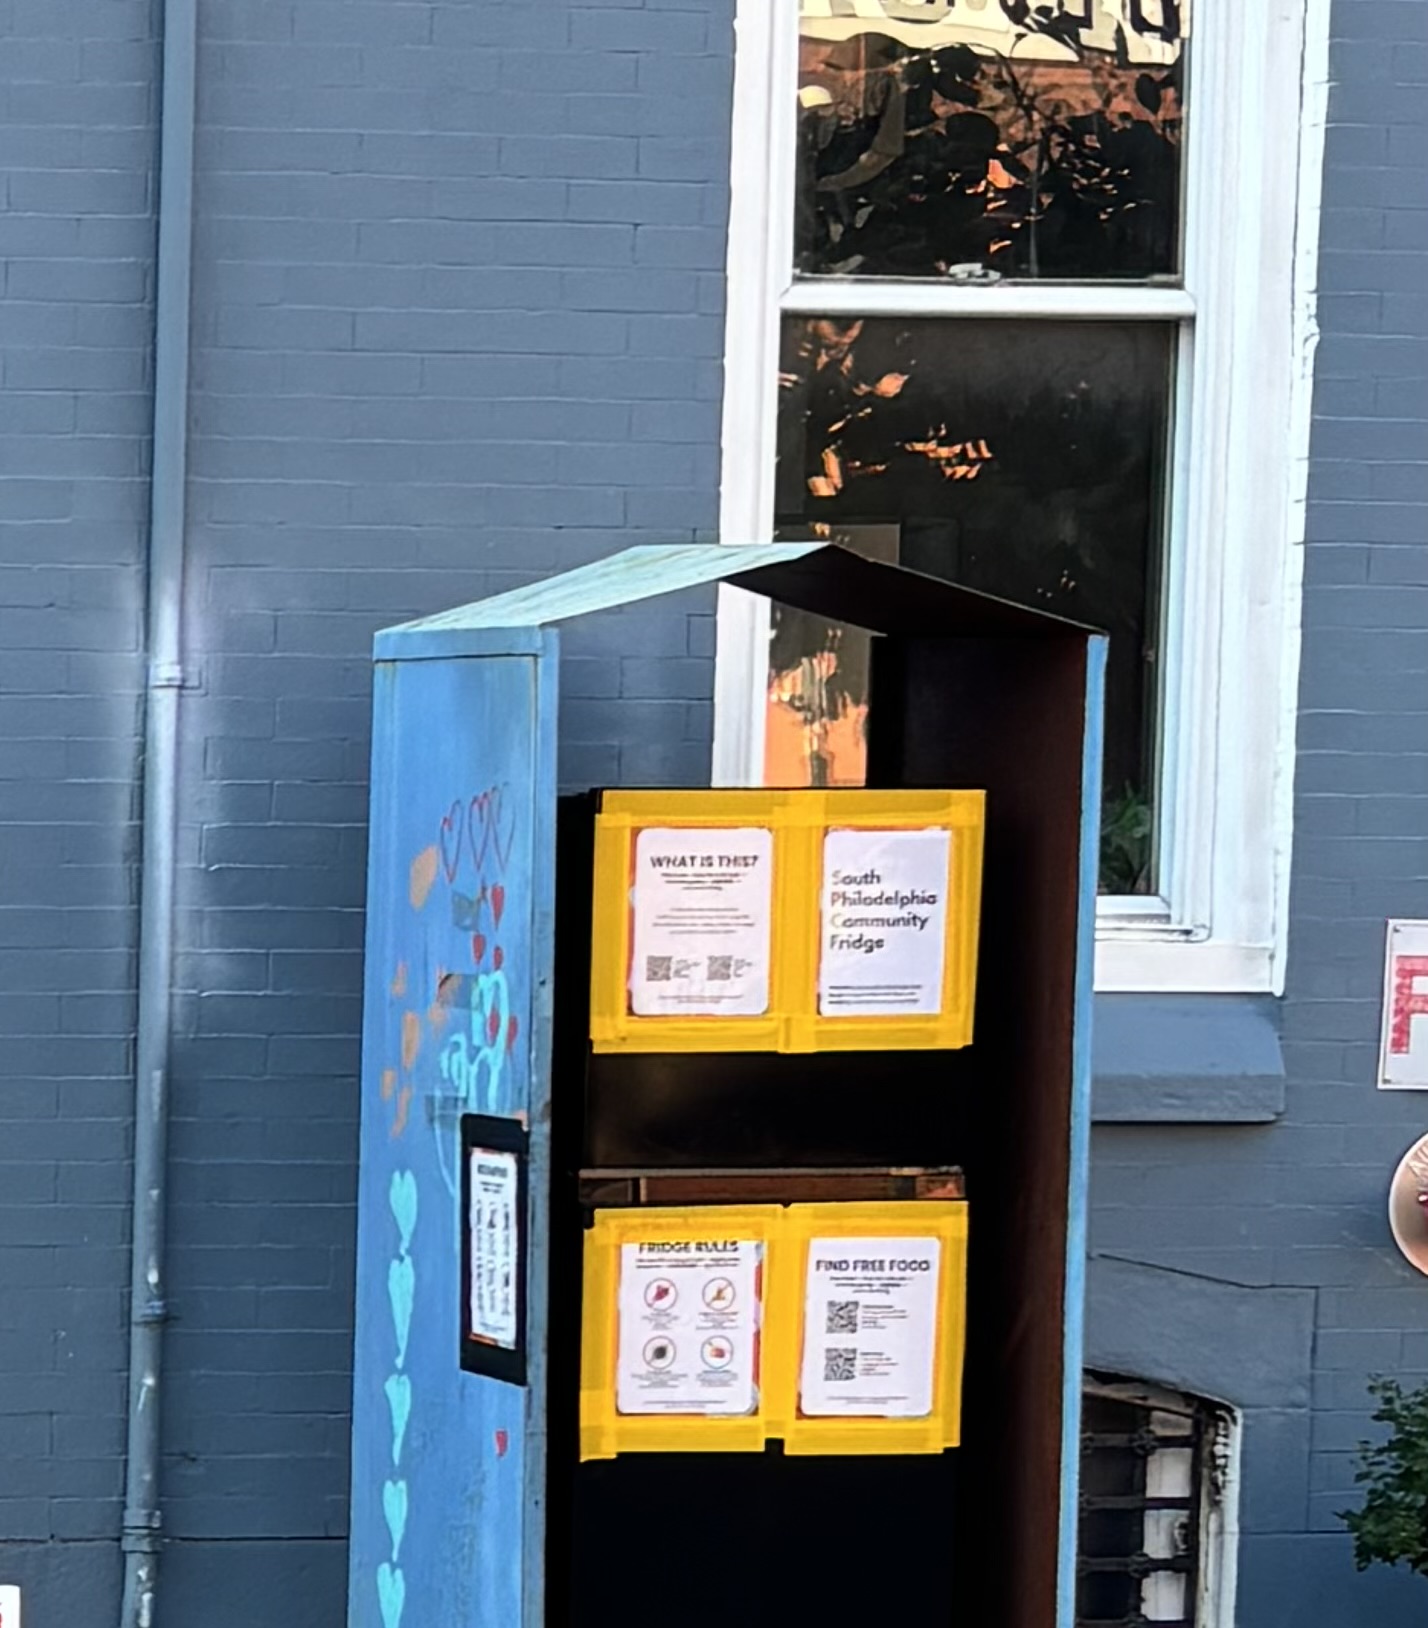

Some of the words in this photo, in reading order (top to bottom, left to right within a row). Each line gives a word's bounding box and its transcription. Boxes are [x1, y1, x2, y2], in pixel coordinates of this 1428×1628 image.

[650, 855, 697, 869] WHAT
[700, 855, 714, 868] IS
[718, 854, 760, 868] THIS?
[831, 869, 882, 886] South
[831, 889, 938, 910] Philadelphia
[831, 911, 930, 931] Community
[830, 932, 885, 954] Fridge
[639, 1240, 691, 1254] FRIDGE
[695, 1239, 739, 1253] RULES
[815, 1259, 850, 1272] FIND
[852, 1259, 885, 1272] FREE
[889, 1259, 930, 1273] FOOD
